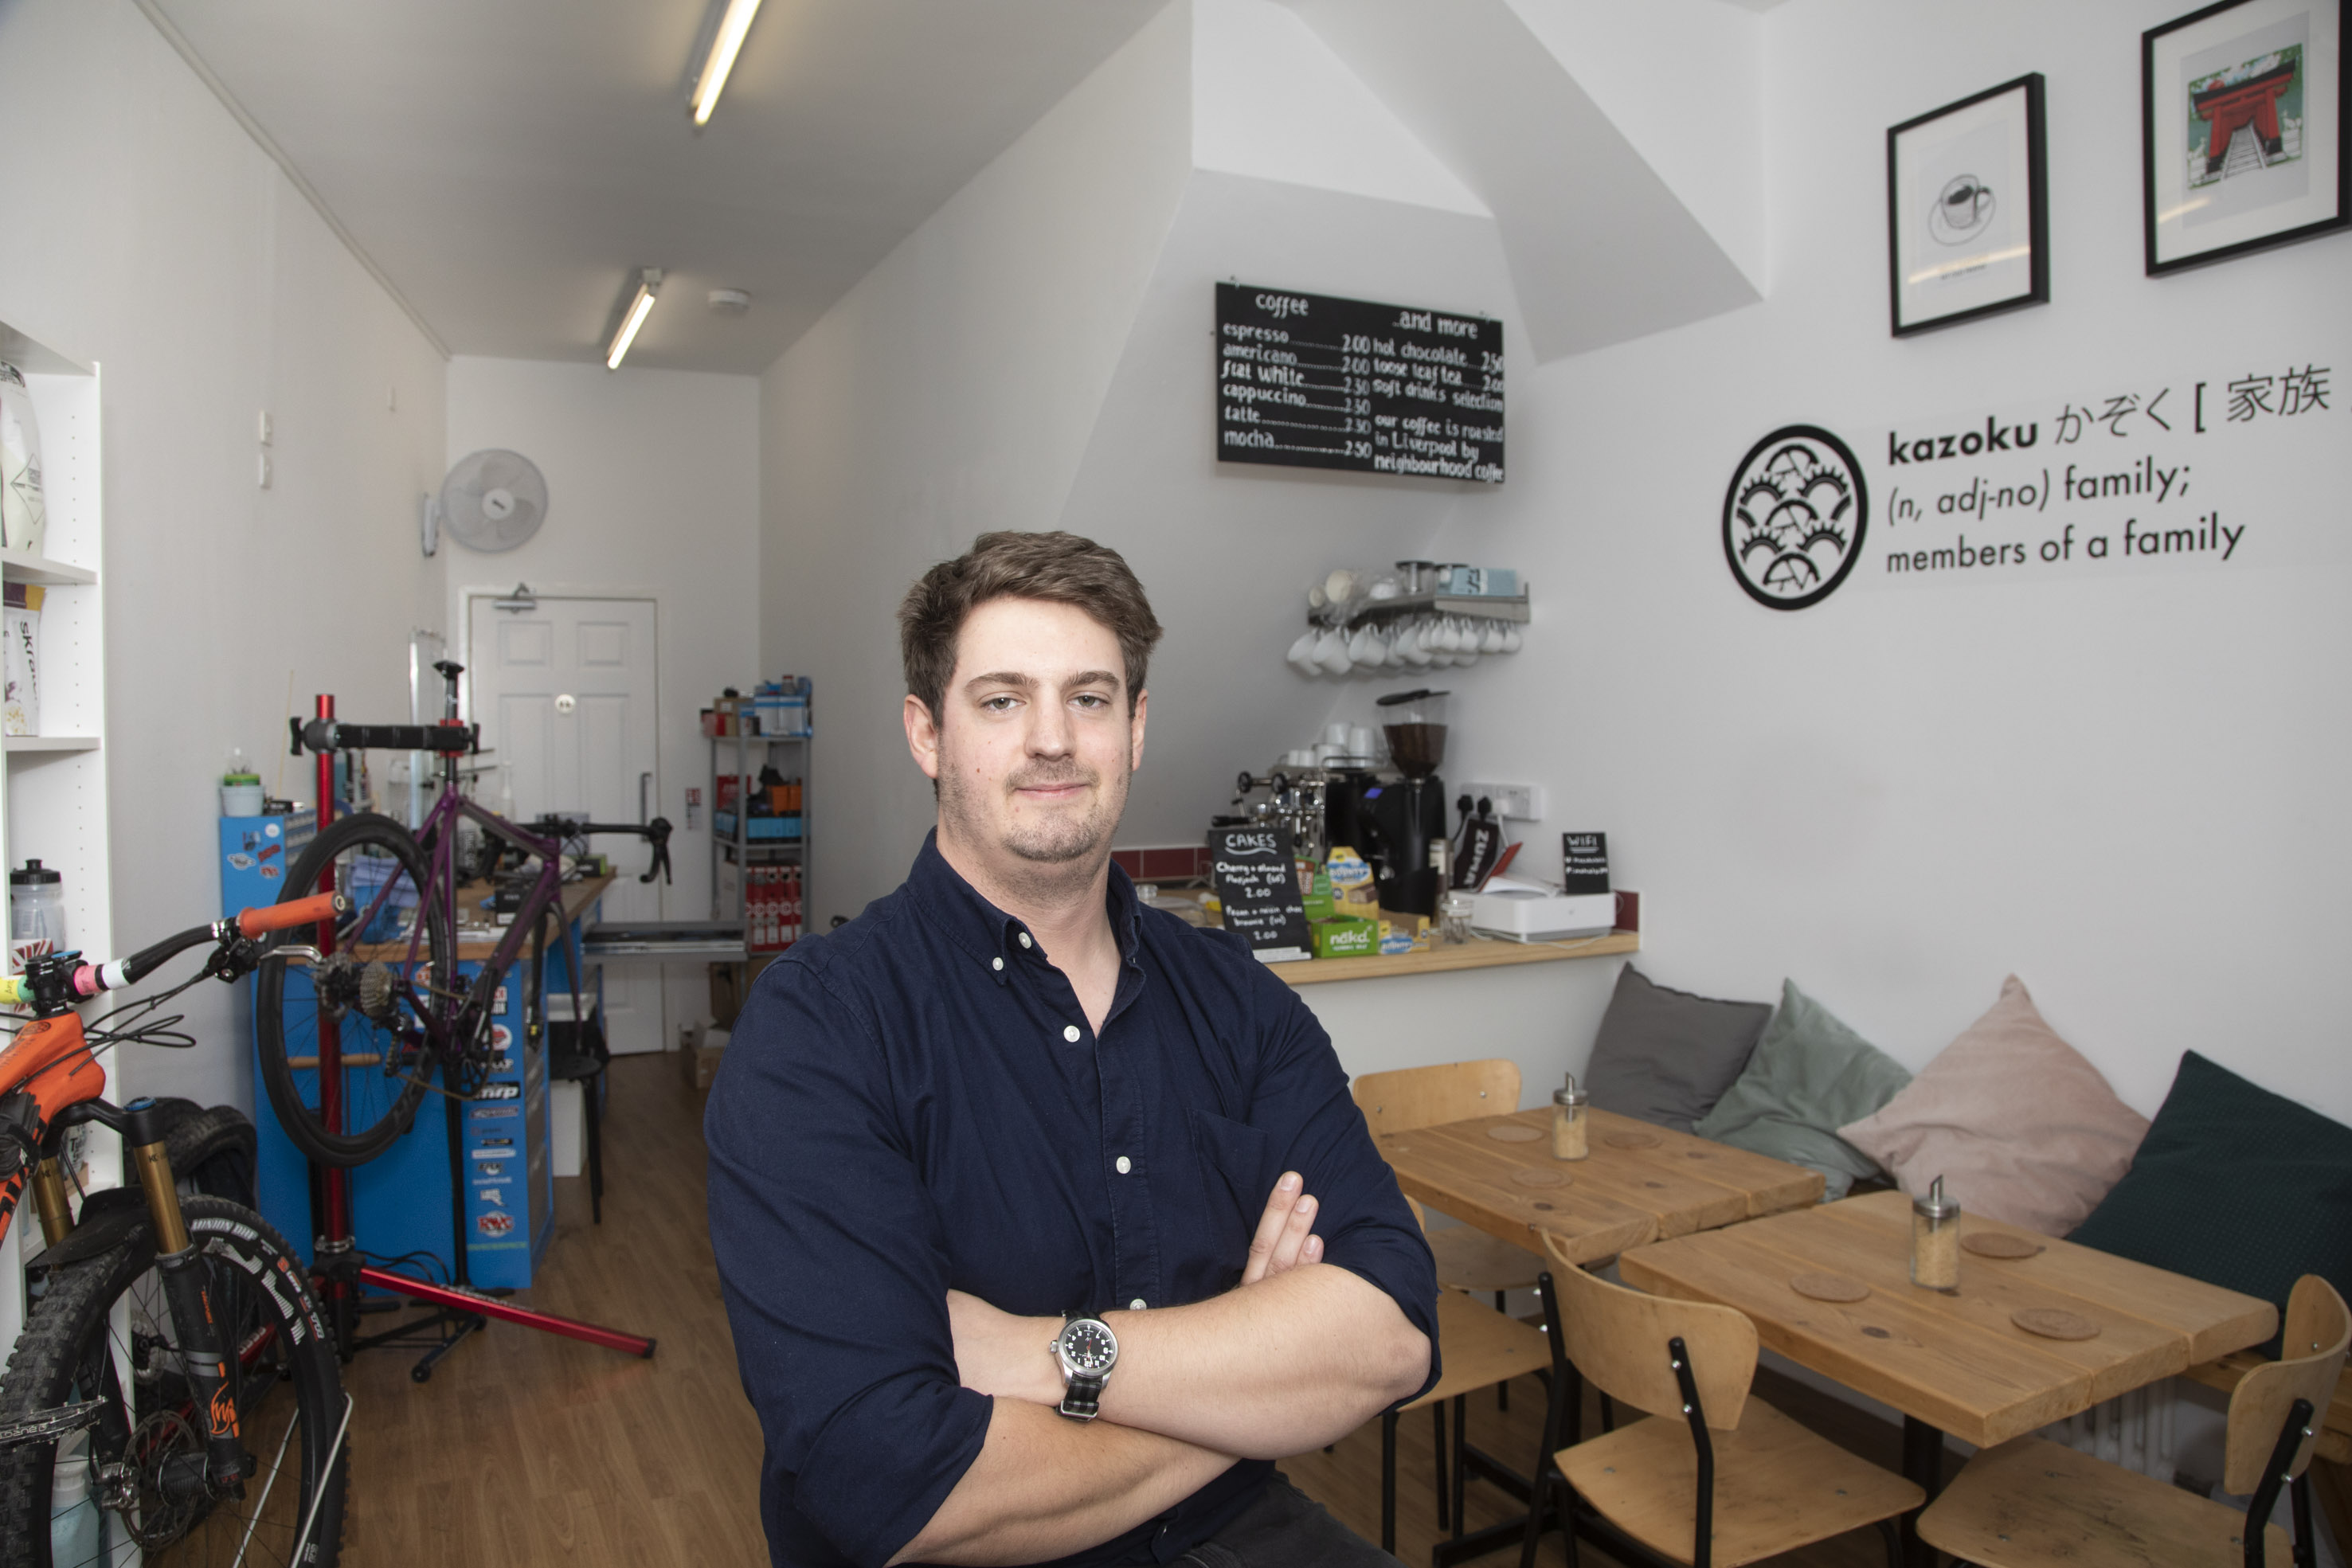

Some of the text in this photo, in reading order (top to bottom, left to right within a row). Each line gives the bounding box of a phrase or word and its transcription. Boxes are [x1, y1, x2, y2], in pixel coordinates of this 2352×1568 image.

[1255, 293, 1309, 319] coffee
[1223, 323, 1289, 344] espresso
[1437, 318, 1478, 339] more
[1223, 342, 1297, 366] americano
[1373, 338, 1396, 357] hot
[1400, 341, 1467, 368] chocolate
[1220, 360, 1252, 380] flat
[1258, 366, 1305, 387] white
[1373, 357, 1408, 377] loose
[1412, 362, 1438, 385] leaf
[1440, 365, 1462, 385] tea
[1223, 383, 1306, 408] cappuccino
[1404, 381, 1446, 403] drinks
[1452, 390, 1504, 413] selection
[1224, 405, 1261, 424] latte
[1888, 415, 2037, 466] kazoku
[2055, 387, 2170, 445] かぞく
[2227, 363, 2331, 423] 家族
[1224, 428, 1274, 448] mocha
[1374, 414, 1504, 443] our coffee is roasted
[1375, 431, 1479, 464] in Liverpool by
[1374, 452, 1504, 483] neighbourhood coffee
[1888, 455, 2190, 526] (n, adj-no) family;
[1887, 511, 2245, 573] members of a family
[1225, 833, 1277, 848] CAKES
[1216, 861, 1250, 875] Cherry
